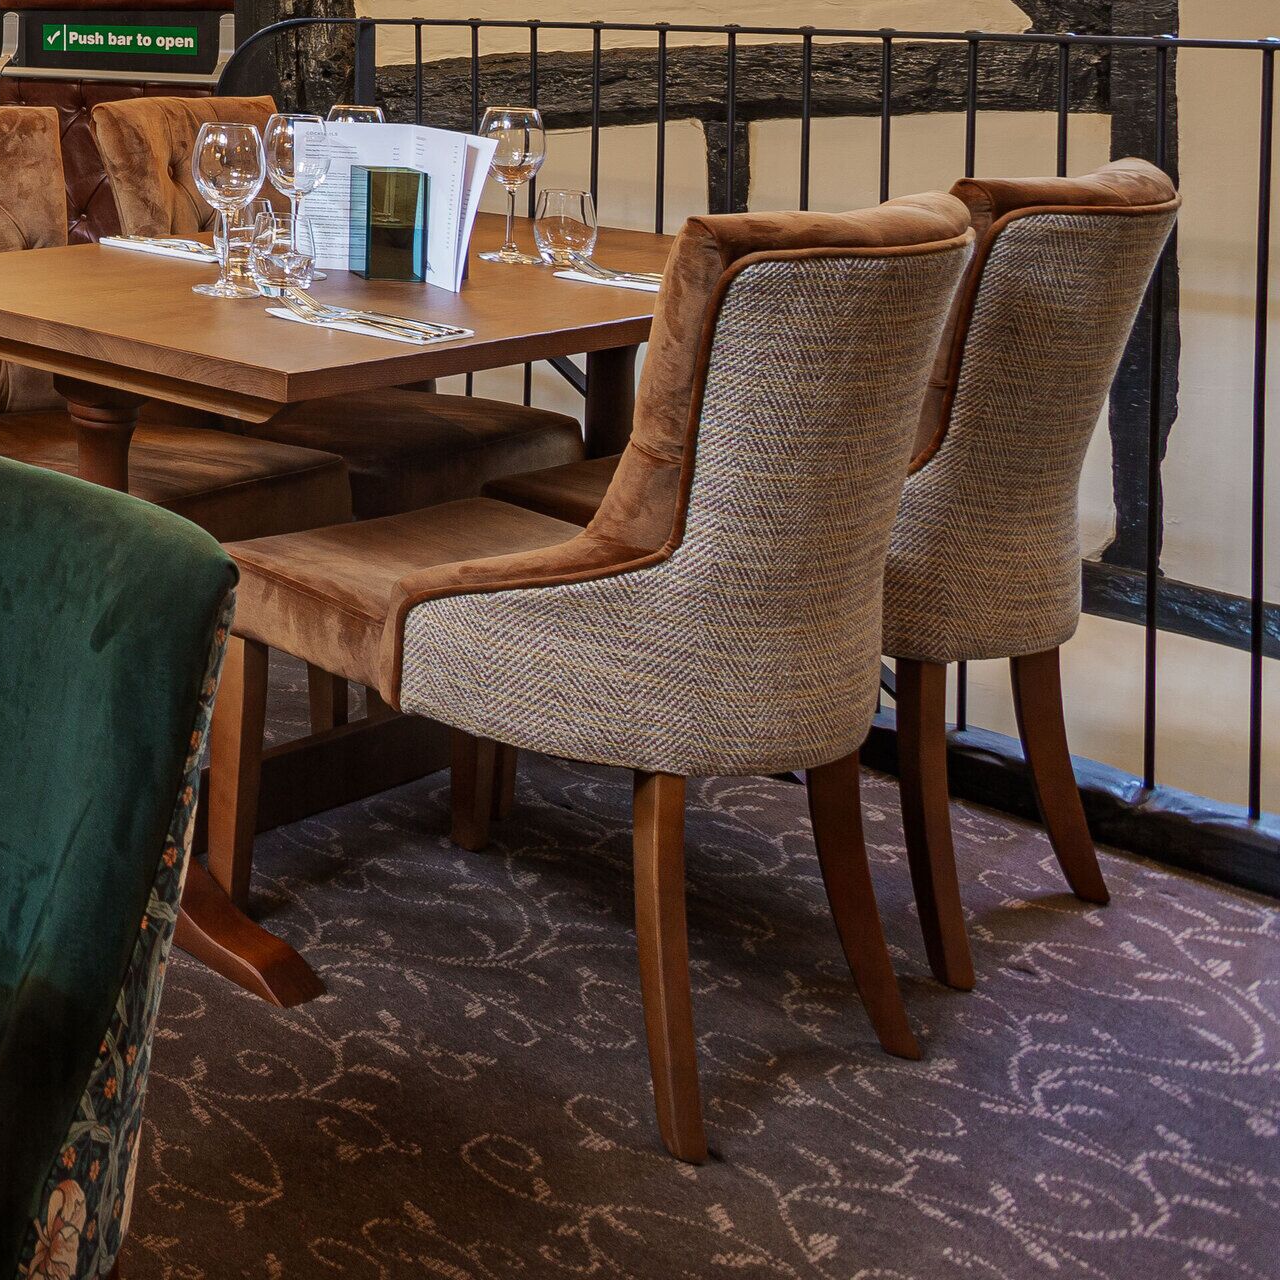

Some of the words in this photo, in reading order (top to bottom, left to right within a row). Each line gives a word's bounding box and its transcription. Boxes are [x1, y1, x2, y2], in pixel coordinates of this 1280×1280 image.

[69, 32, 104, 45] Push
[108, 33, 132, 46] bar
[137, 34, 152, 46] to
[156, 37, 194, 50] open
